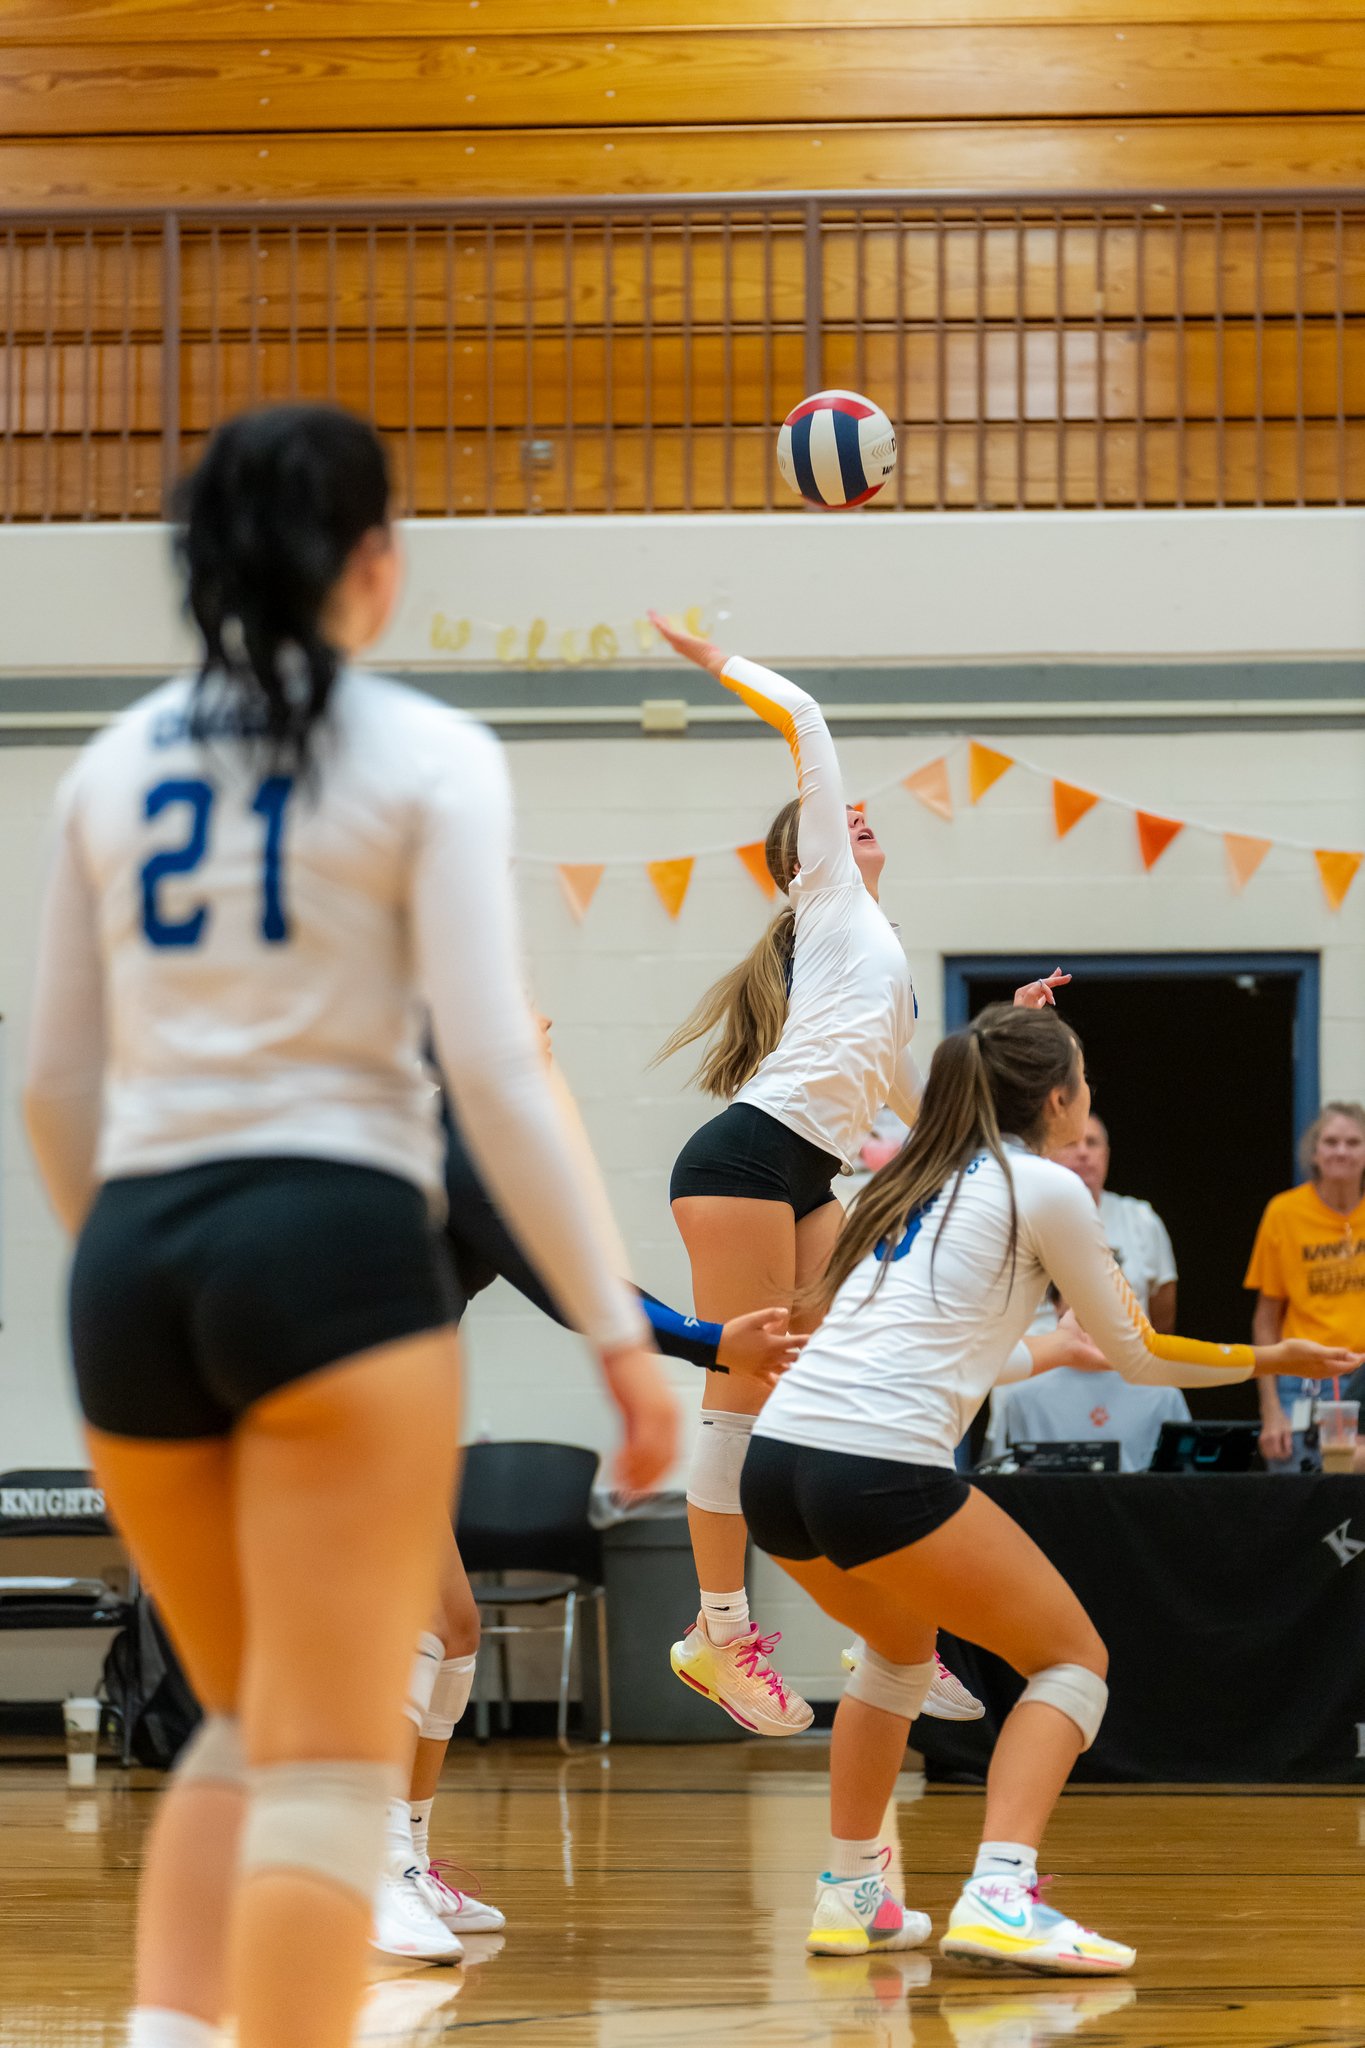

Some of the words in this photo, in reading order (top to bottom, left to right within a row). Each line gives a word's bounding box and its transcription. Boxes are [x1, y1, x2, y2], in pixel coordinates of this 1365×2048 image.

[142, 776, 293, 946] 21
[1, 1487, 107, 1516] KNIGHTS
[1321, 1518, 1365, 1568] K
